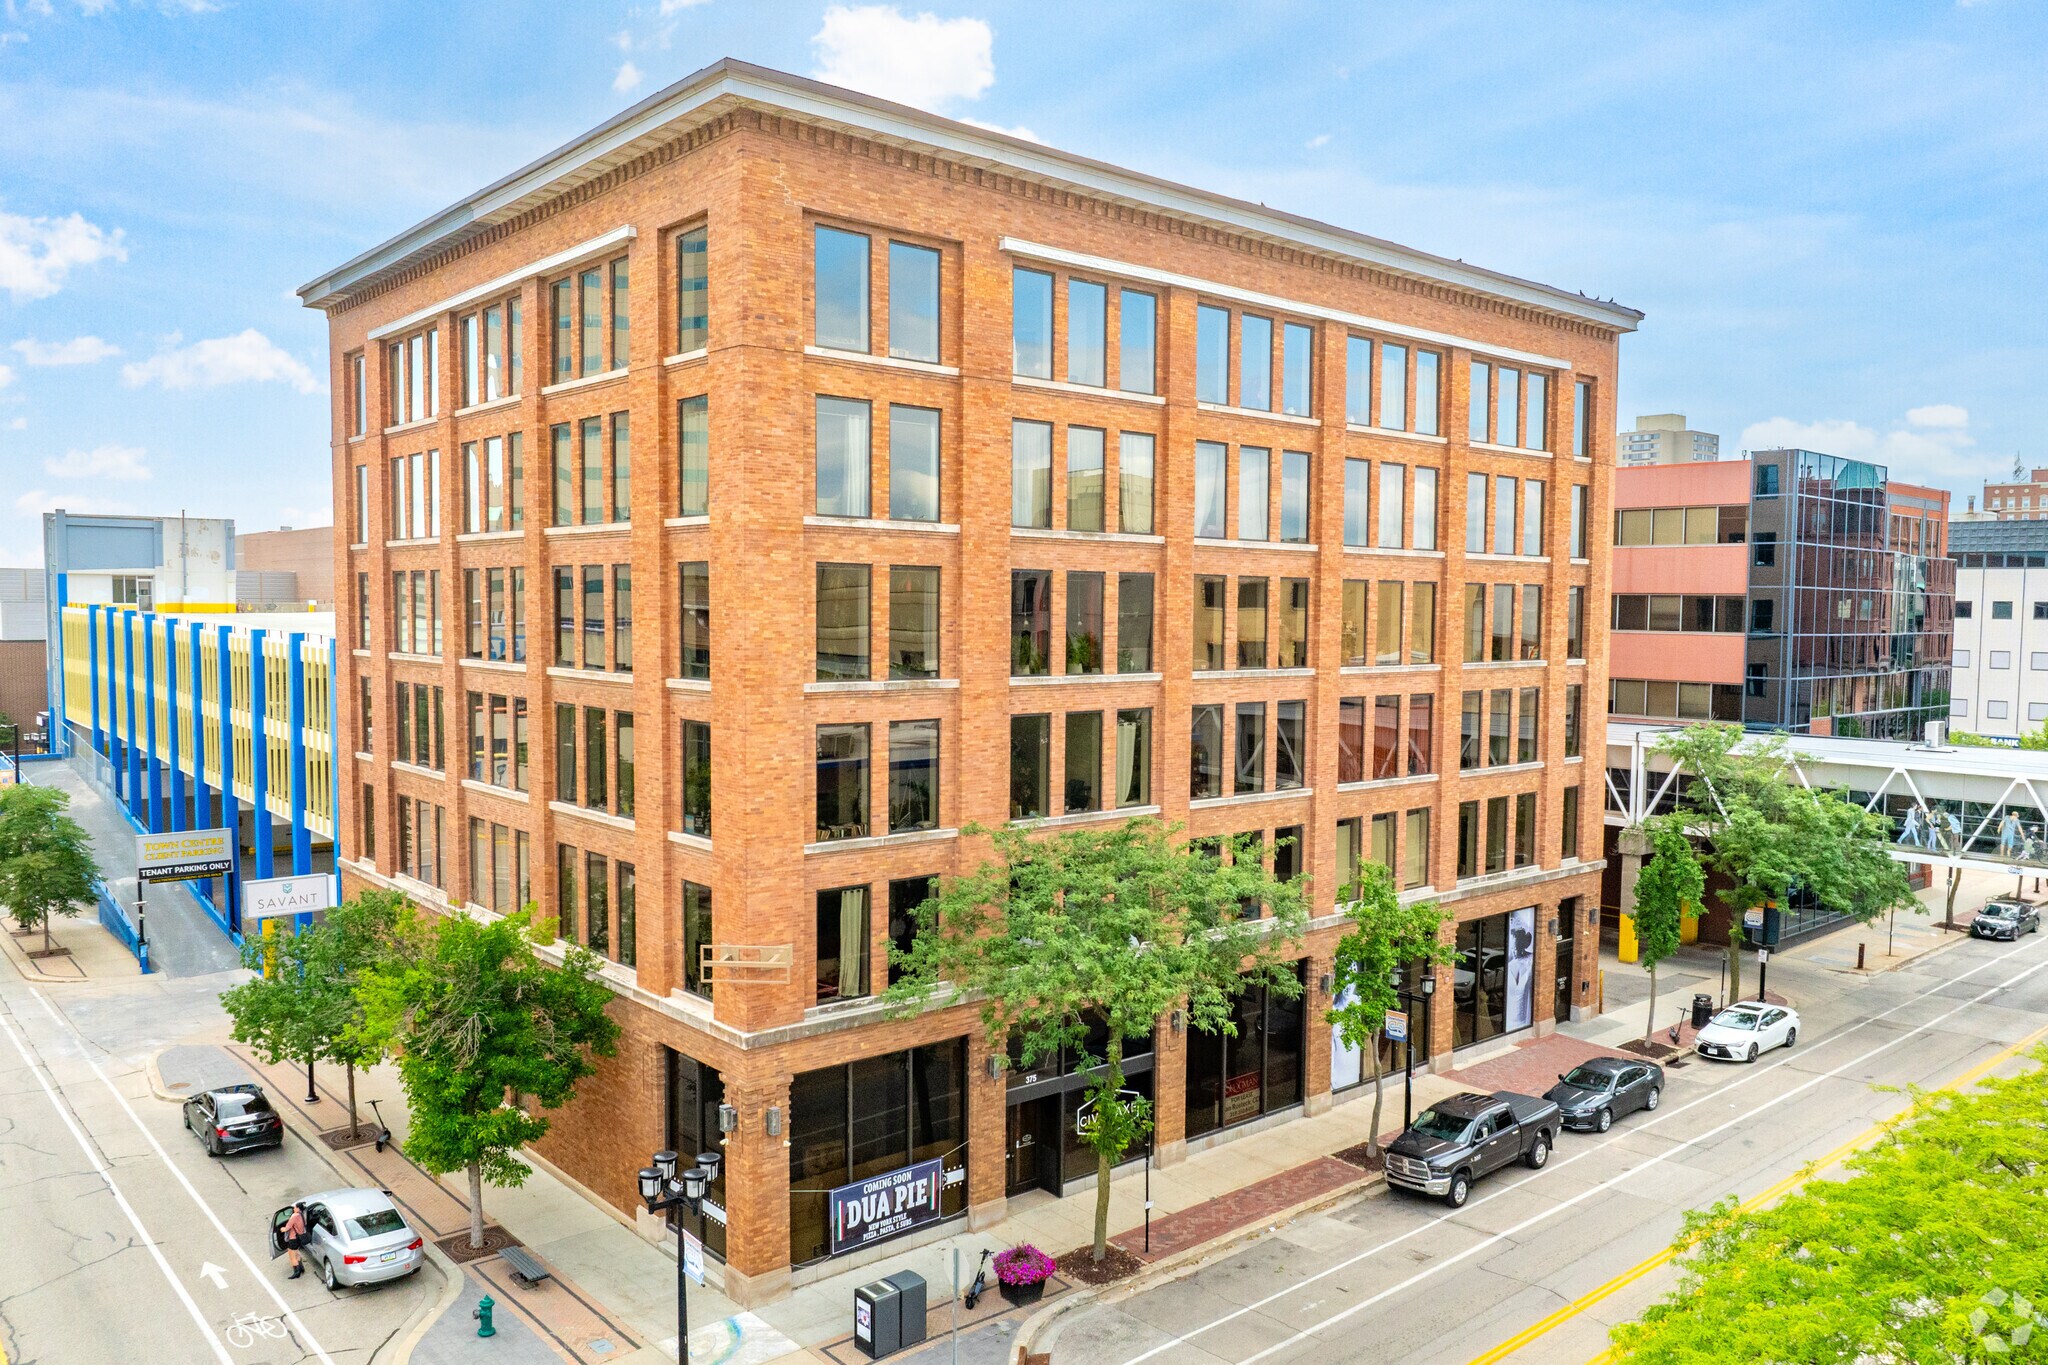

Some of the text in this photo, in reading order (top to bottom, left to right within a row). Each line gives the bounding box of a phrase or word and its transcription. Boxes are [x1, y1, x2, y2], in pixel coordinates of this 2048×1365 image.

[1991, 737, 2019, 747] BANK
[144, 837, 224, 852] TOWN CENTRE
[144, 847, 224, 861] CLIENT PARKING
[141, 862, 230, 877] TENANT PARKING ONLY
[258, 893, 317, 910] SAVANT
[1025, 1074, 1037, 1084] 375
[864, 1171, 912, 1194] COMING SOON
[847, 1178, 927, 1229] DUA PIE
[868, 1212, 907, 1231] NEW YORK STYLE
[880, 1224, 896, 1236] PASTA,
[900, 1217, 912, 1228] SUBS
